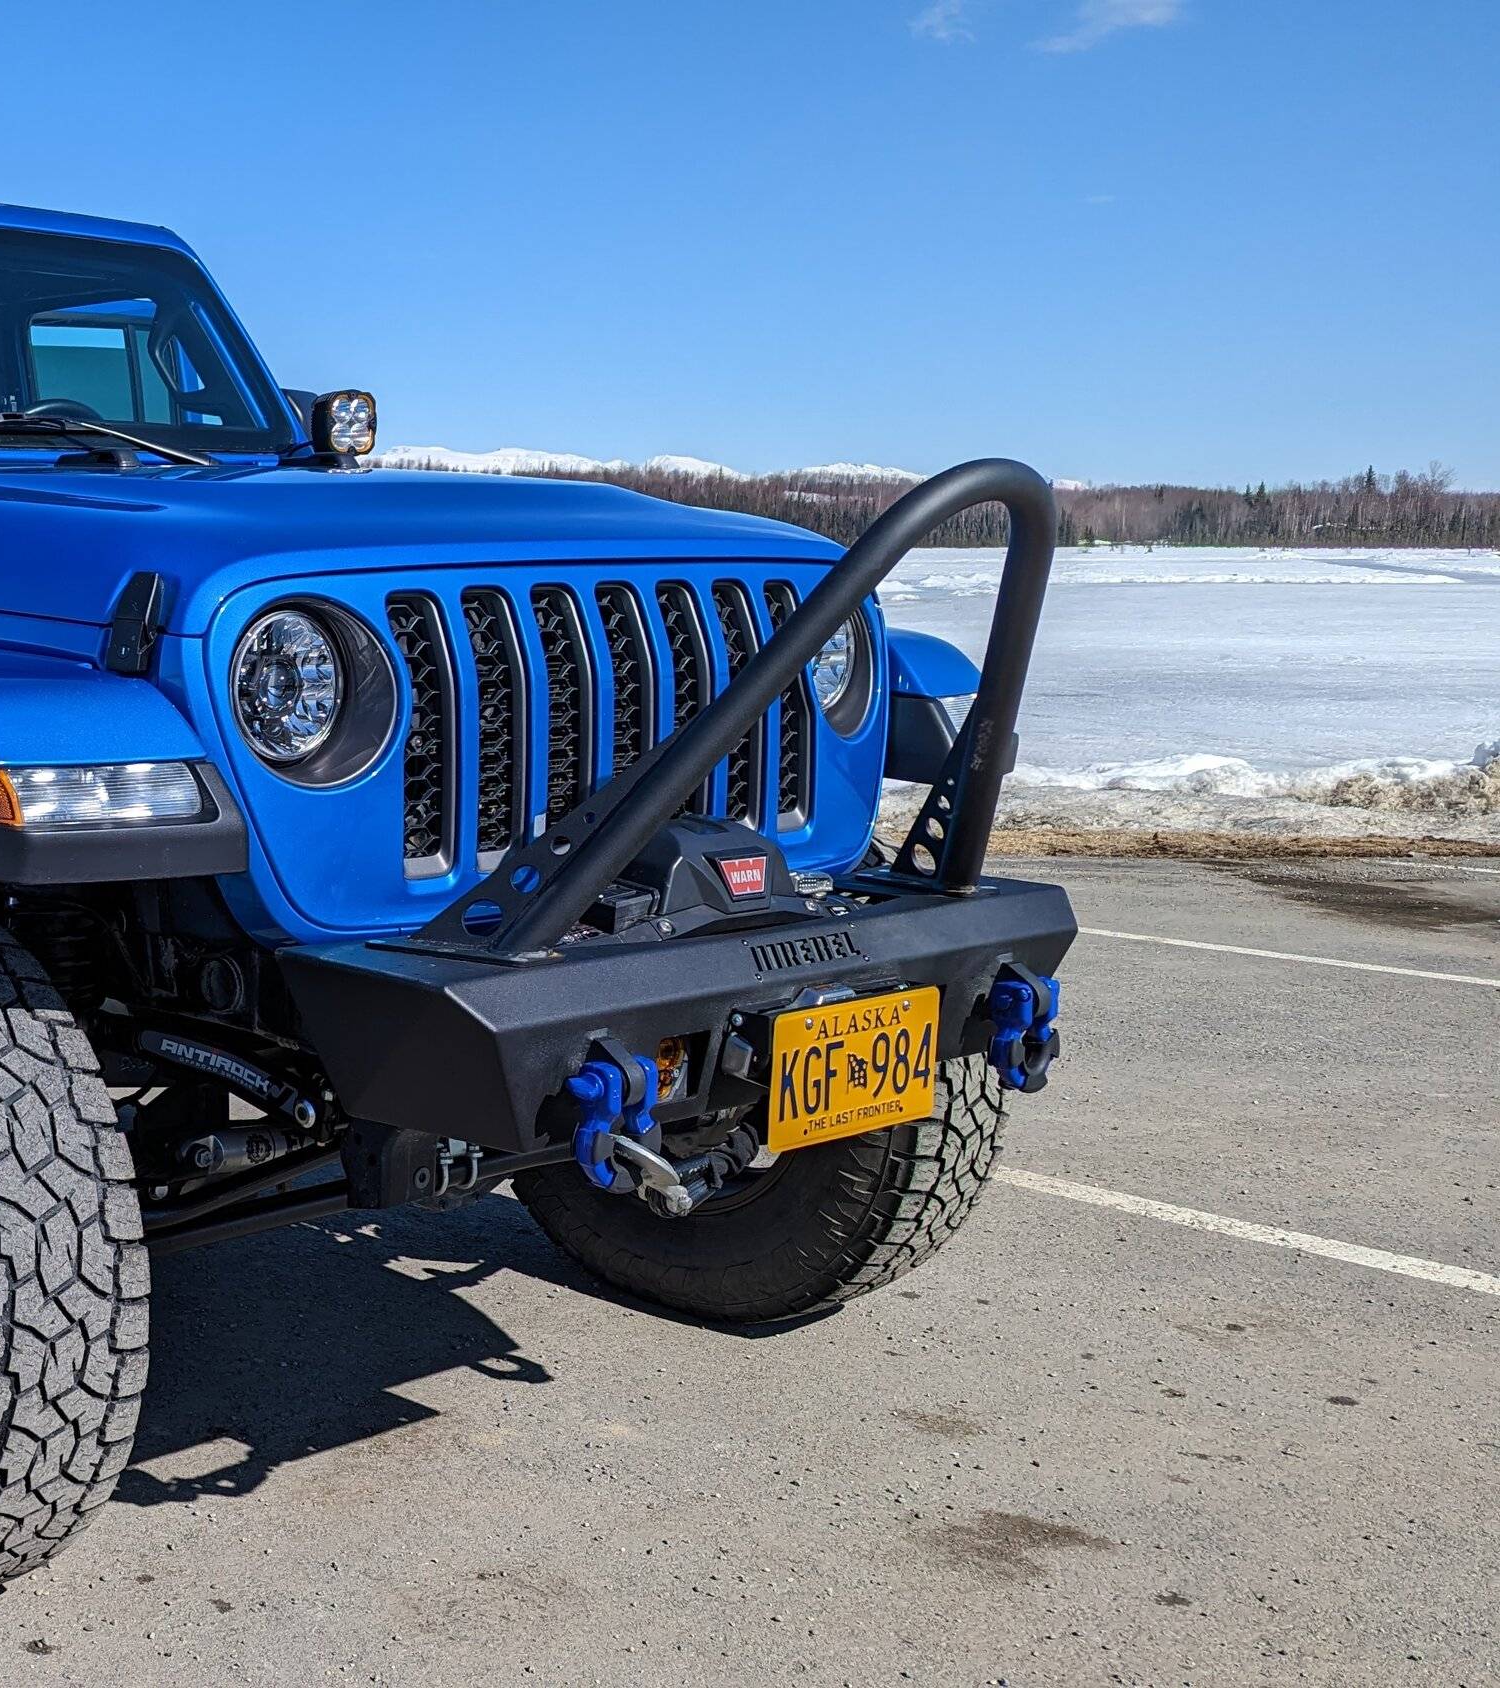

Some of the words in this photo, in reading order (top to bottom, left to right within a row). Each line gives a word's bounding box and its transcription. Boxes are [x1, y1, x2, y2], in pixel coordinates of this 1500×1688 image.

[730, 868, 762, 884] WARN
[815, 1005, 902, 1041] ALASKA
[160, 1038, 270, 1093] ANTIROCK
[779, 1040, 845, 1123] KGF
[871, 1023, 933, 1098] 984
[808, 1115, 827, 1132] THE
[829, 1107, 854, 1127] LAST
[857, 1100, 901, 1121] FRONTIER
